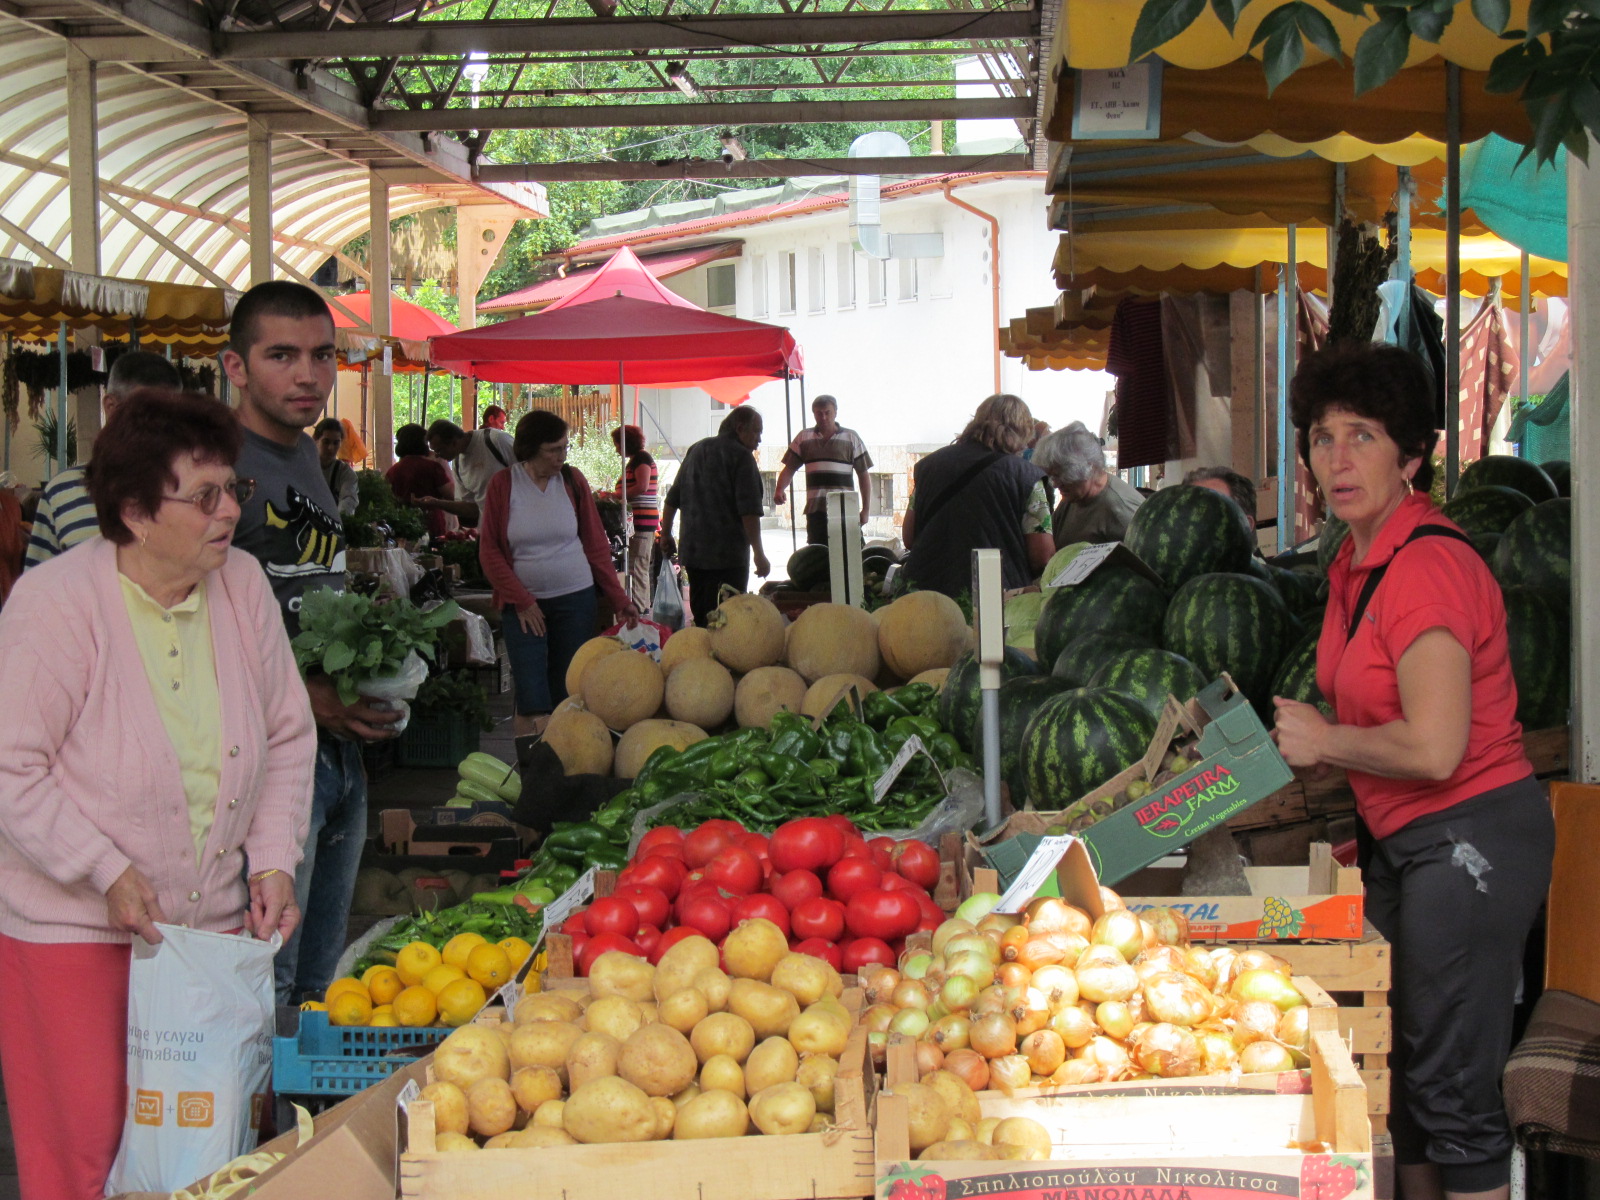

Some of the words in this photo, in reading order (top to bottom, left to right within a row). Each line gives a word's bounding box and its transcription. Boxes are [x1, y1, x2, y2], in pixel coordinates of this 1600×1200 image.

[1133, 763, 1231, 826] IERAPETRA
[1186, 774, 1240, 813] FARM
[1184, 820, 1210, 837] Cretan
[1208, 797, 1248, 823] Vegetables
[155, 1030, 204, 1046] услуги
[1156, 1168, 1277, 1192] Νικολίτσα
